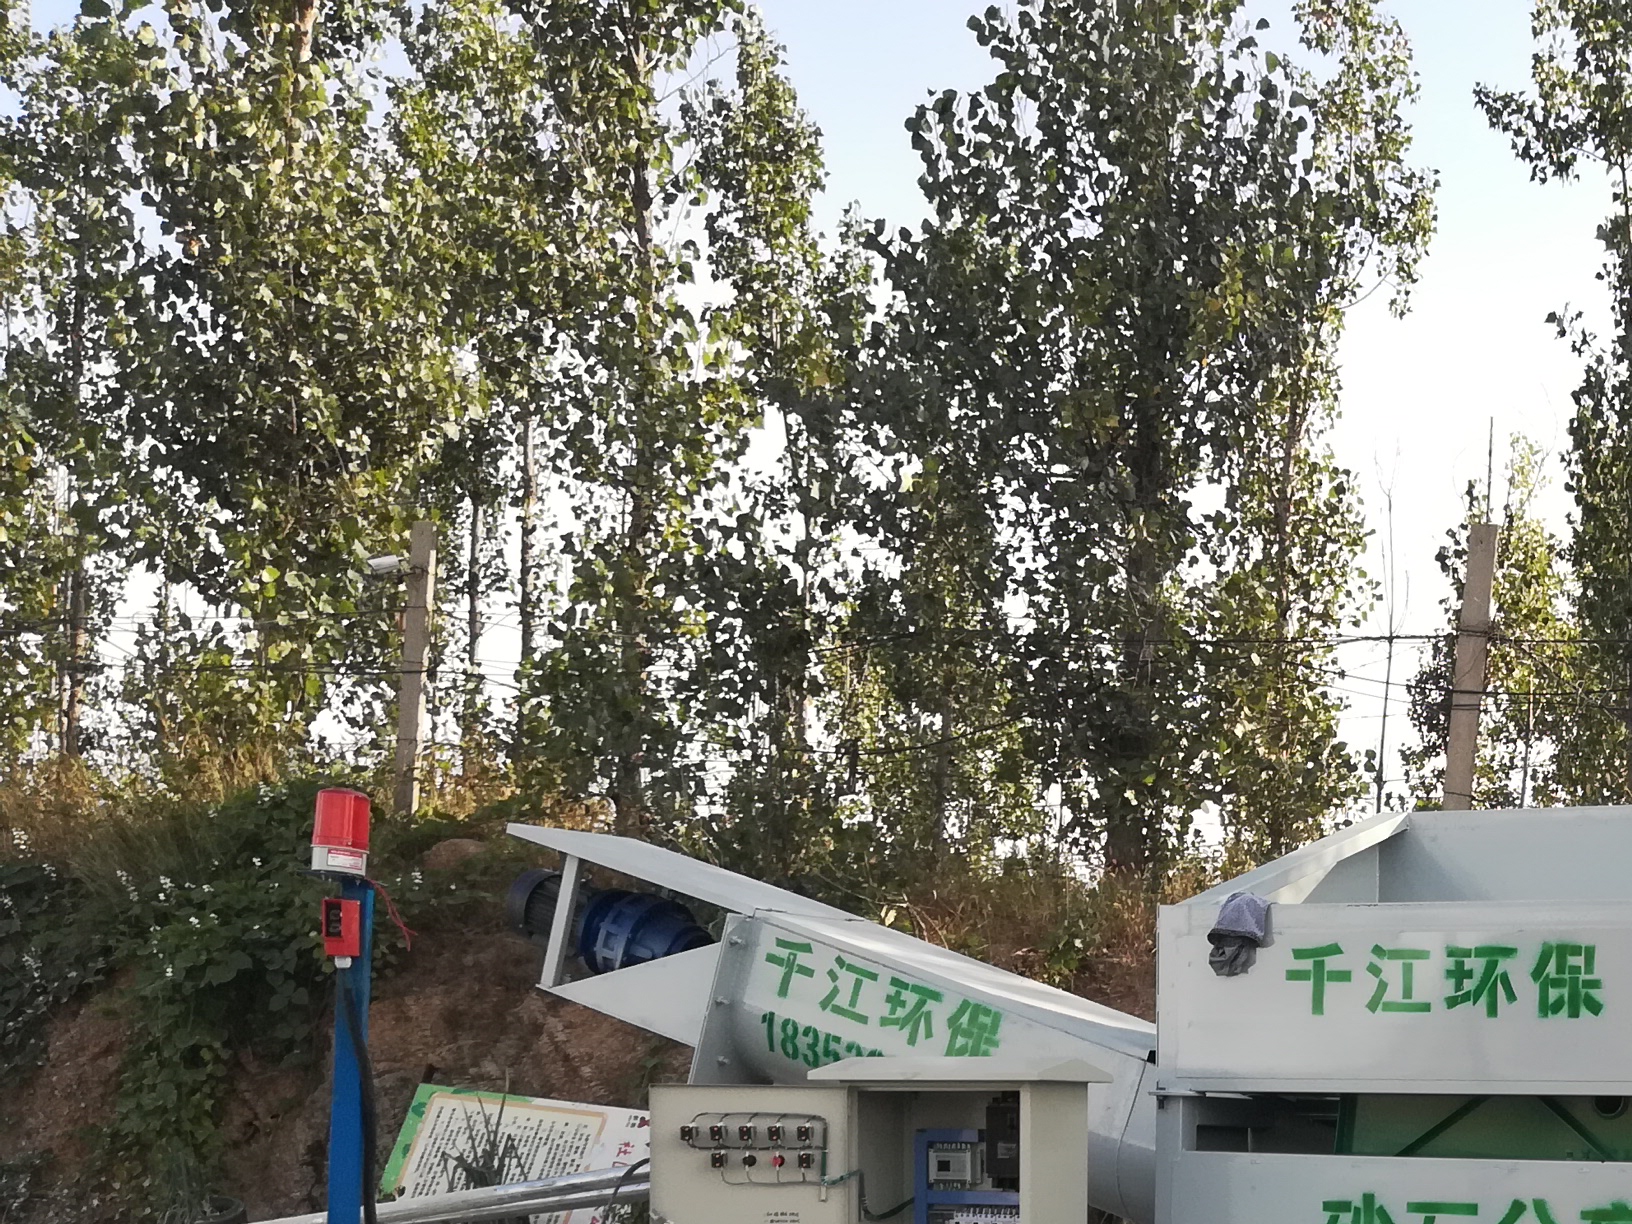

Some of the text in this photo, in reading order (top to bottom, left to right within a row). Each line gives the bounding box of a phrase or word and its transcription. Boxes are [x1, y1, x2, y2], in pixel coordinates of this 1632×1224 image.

[764, 936, 1004, 1057] 千江环保
[1285, 940, 1604, 1019] 千江环保
